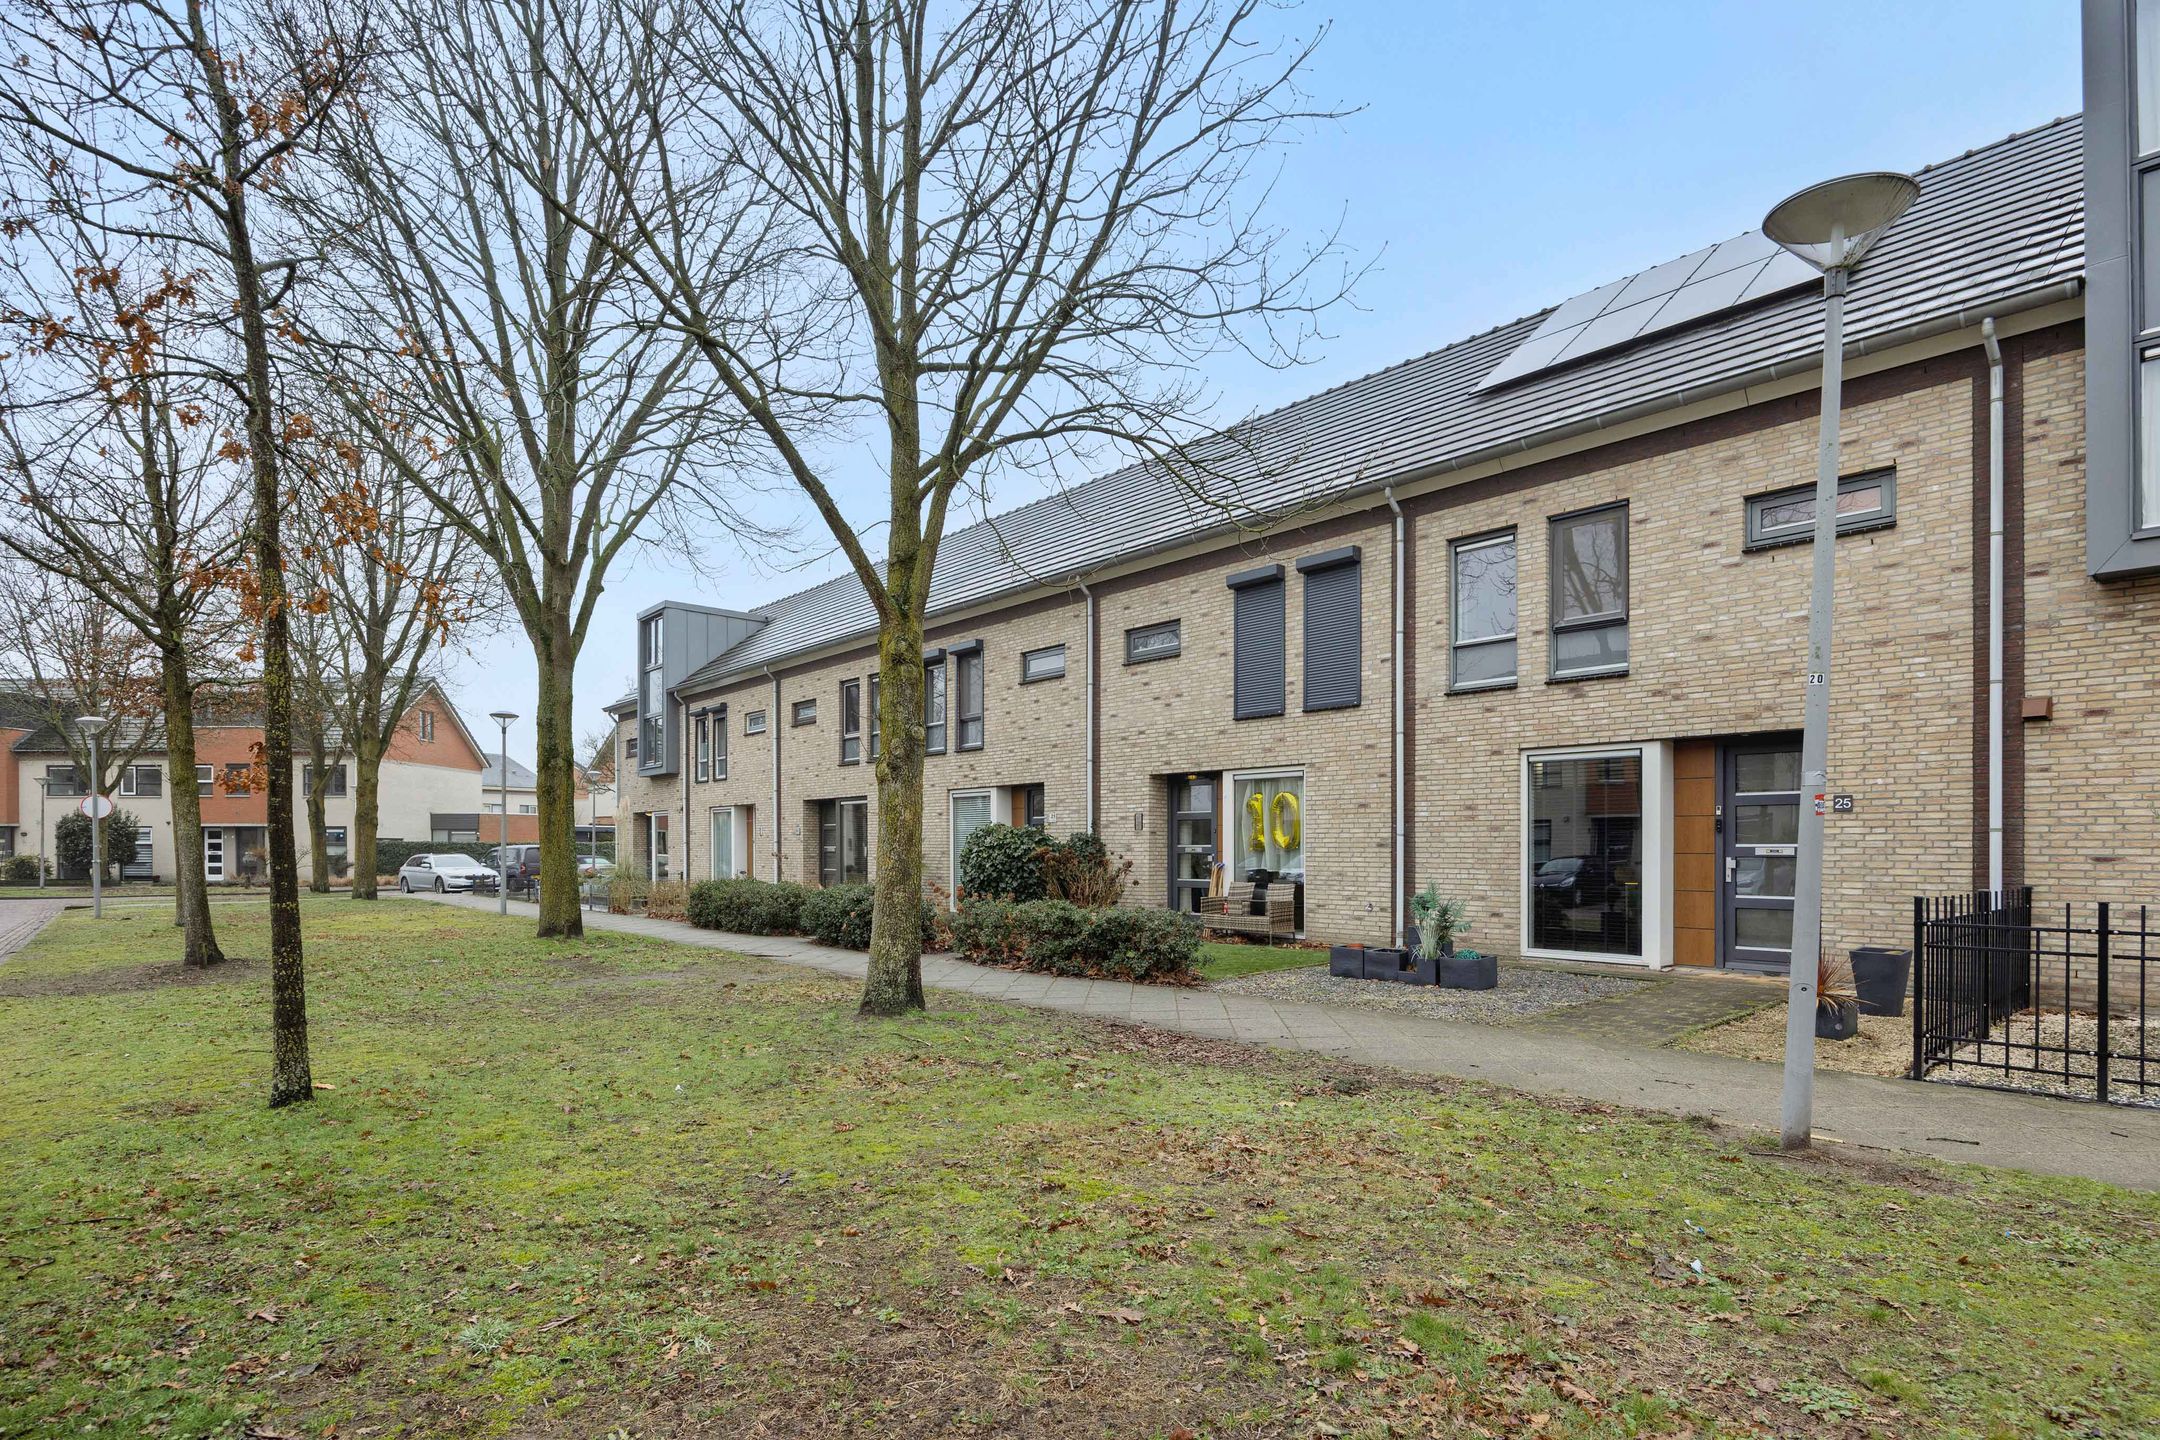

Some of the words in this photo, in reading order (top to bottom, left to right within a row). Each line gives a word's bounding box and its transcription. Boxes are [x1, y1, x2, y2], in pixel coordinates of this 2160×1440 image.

[1810, 674, 1823, 684] 20
[1834, 798, 1852, 809] 25
[1247, 791, 1300, 851] 10
